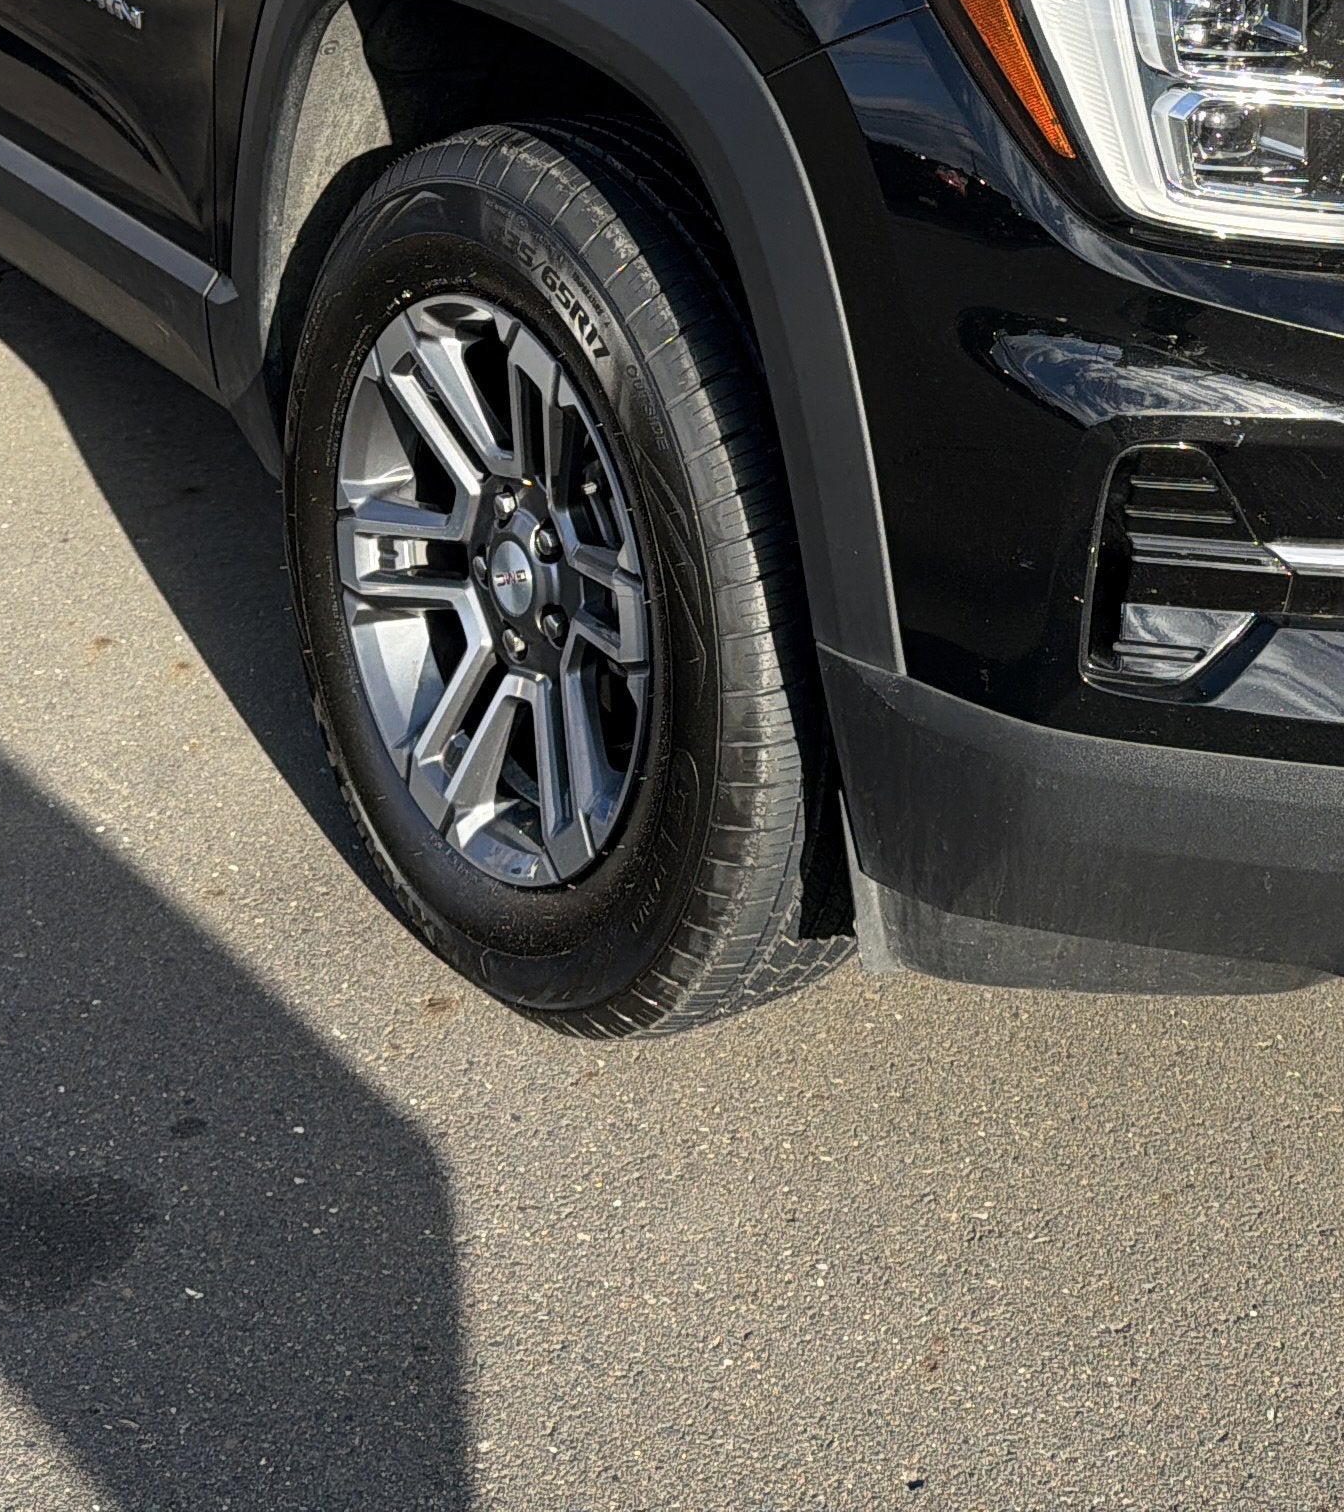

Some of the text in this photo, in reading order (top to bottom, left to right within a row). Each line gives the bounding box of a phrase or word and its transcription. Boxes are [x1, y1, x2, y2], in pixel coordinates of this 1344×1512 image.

[499, 227, 610, 360] 35/65R17
[625, 364, 670, 451] OUTSIDE
[495, 570, 528, 587] GMC
